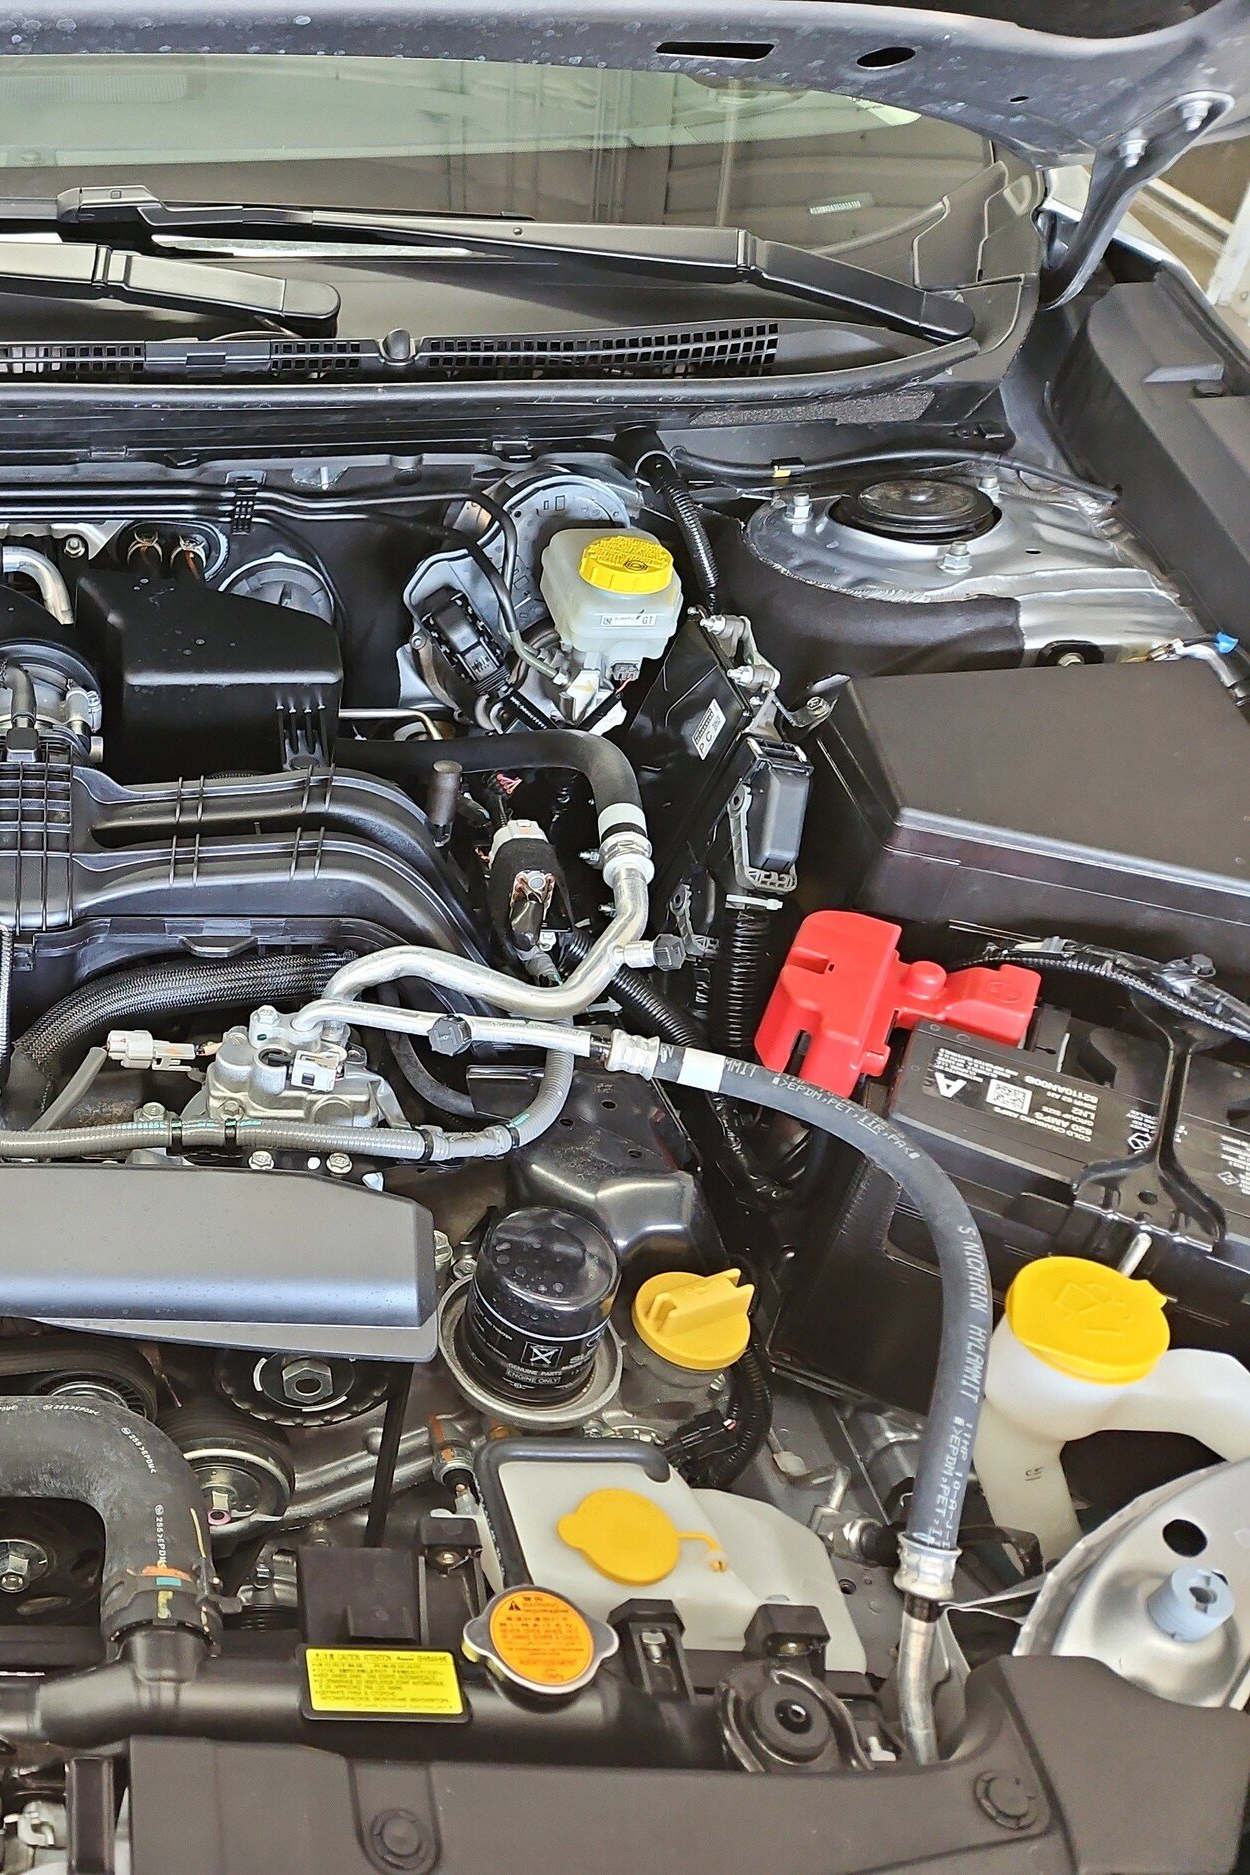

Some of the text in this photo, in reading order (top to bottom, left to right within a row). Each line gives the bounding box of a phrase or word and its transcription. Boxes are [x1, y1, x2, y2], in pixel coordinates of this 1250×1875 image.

[725, 1057, 759, 1077] MMIT
[1034, 1112, 1070, 1128] AMPS
[1041, 1105, 1094, 1126] GROUP SIZE
[1071, 1107, 1095, 1120] LN2
[993, 1107, 1091, 1142] COLD CRANKING AMPS
[509, 1363, 538, 1375] GENUINE
[960, 1325, 987, 1403] HYLAMMIT
[508, 1370, 538, 1383] ENGINE
